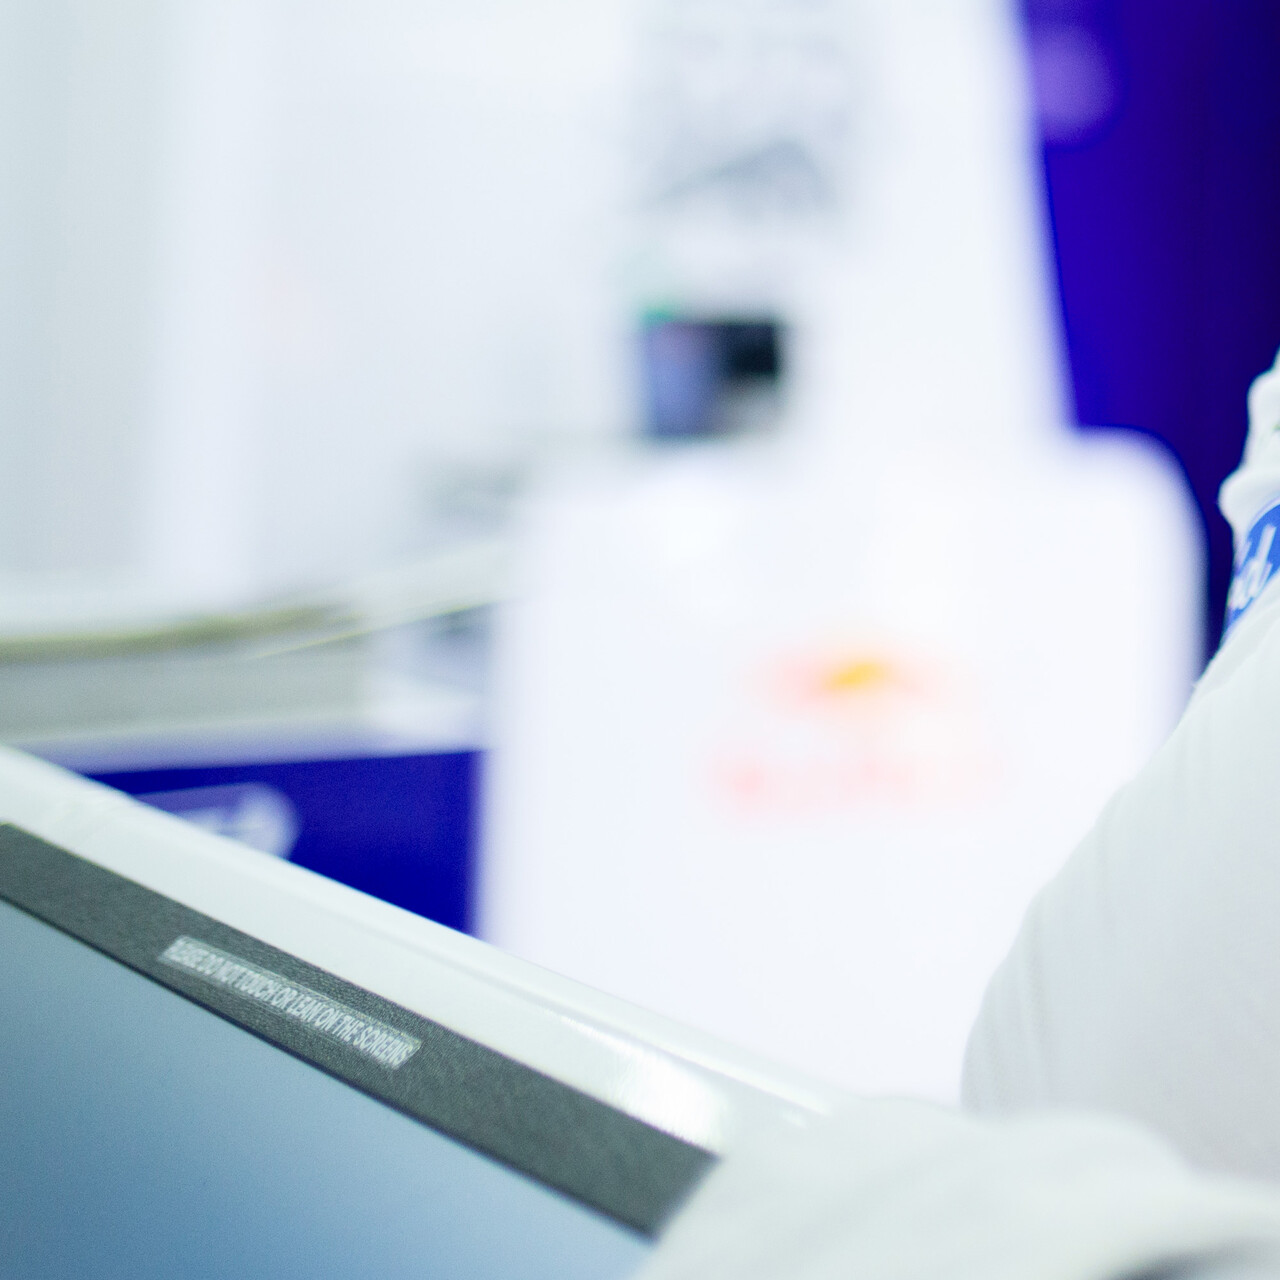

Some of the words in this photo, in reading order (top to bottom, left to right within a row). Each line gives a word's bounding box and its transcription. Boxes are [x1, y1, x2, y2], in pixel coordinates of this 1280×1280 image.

[232, 969, 283, 1001] TOUCH
[268, 986, 299, 1010] OR
[285, 993, 326, 1022] LEAN
[313, 1006, 345, 1032] ON
[331, 1014, 366, 1042] THE
[351, 1024, 415, 1067] SCREENS
